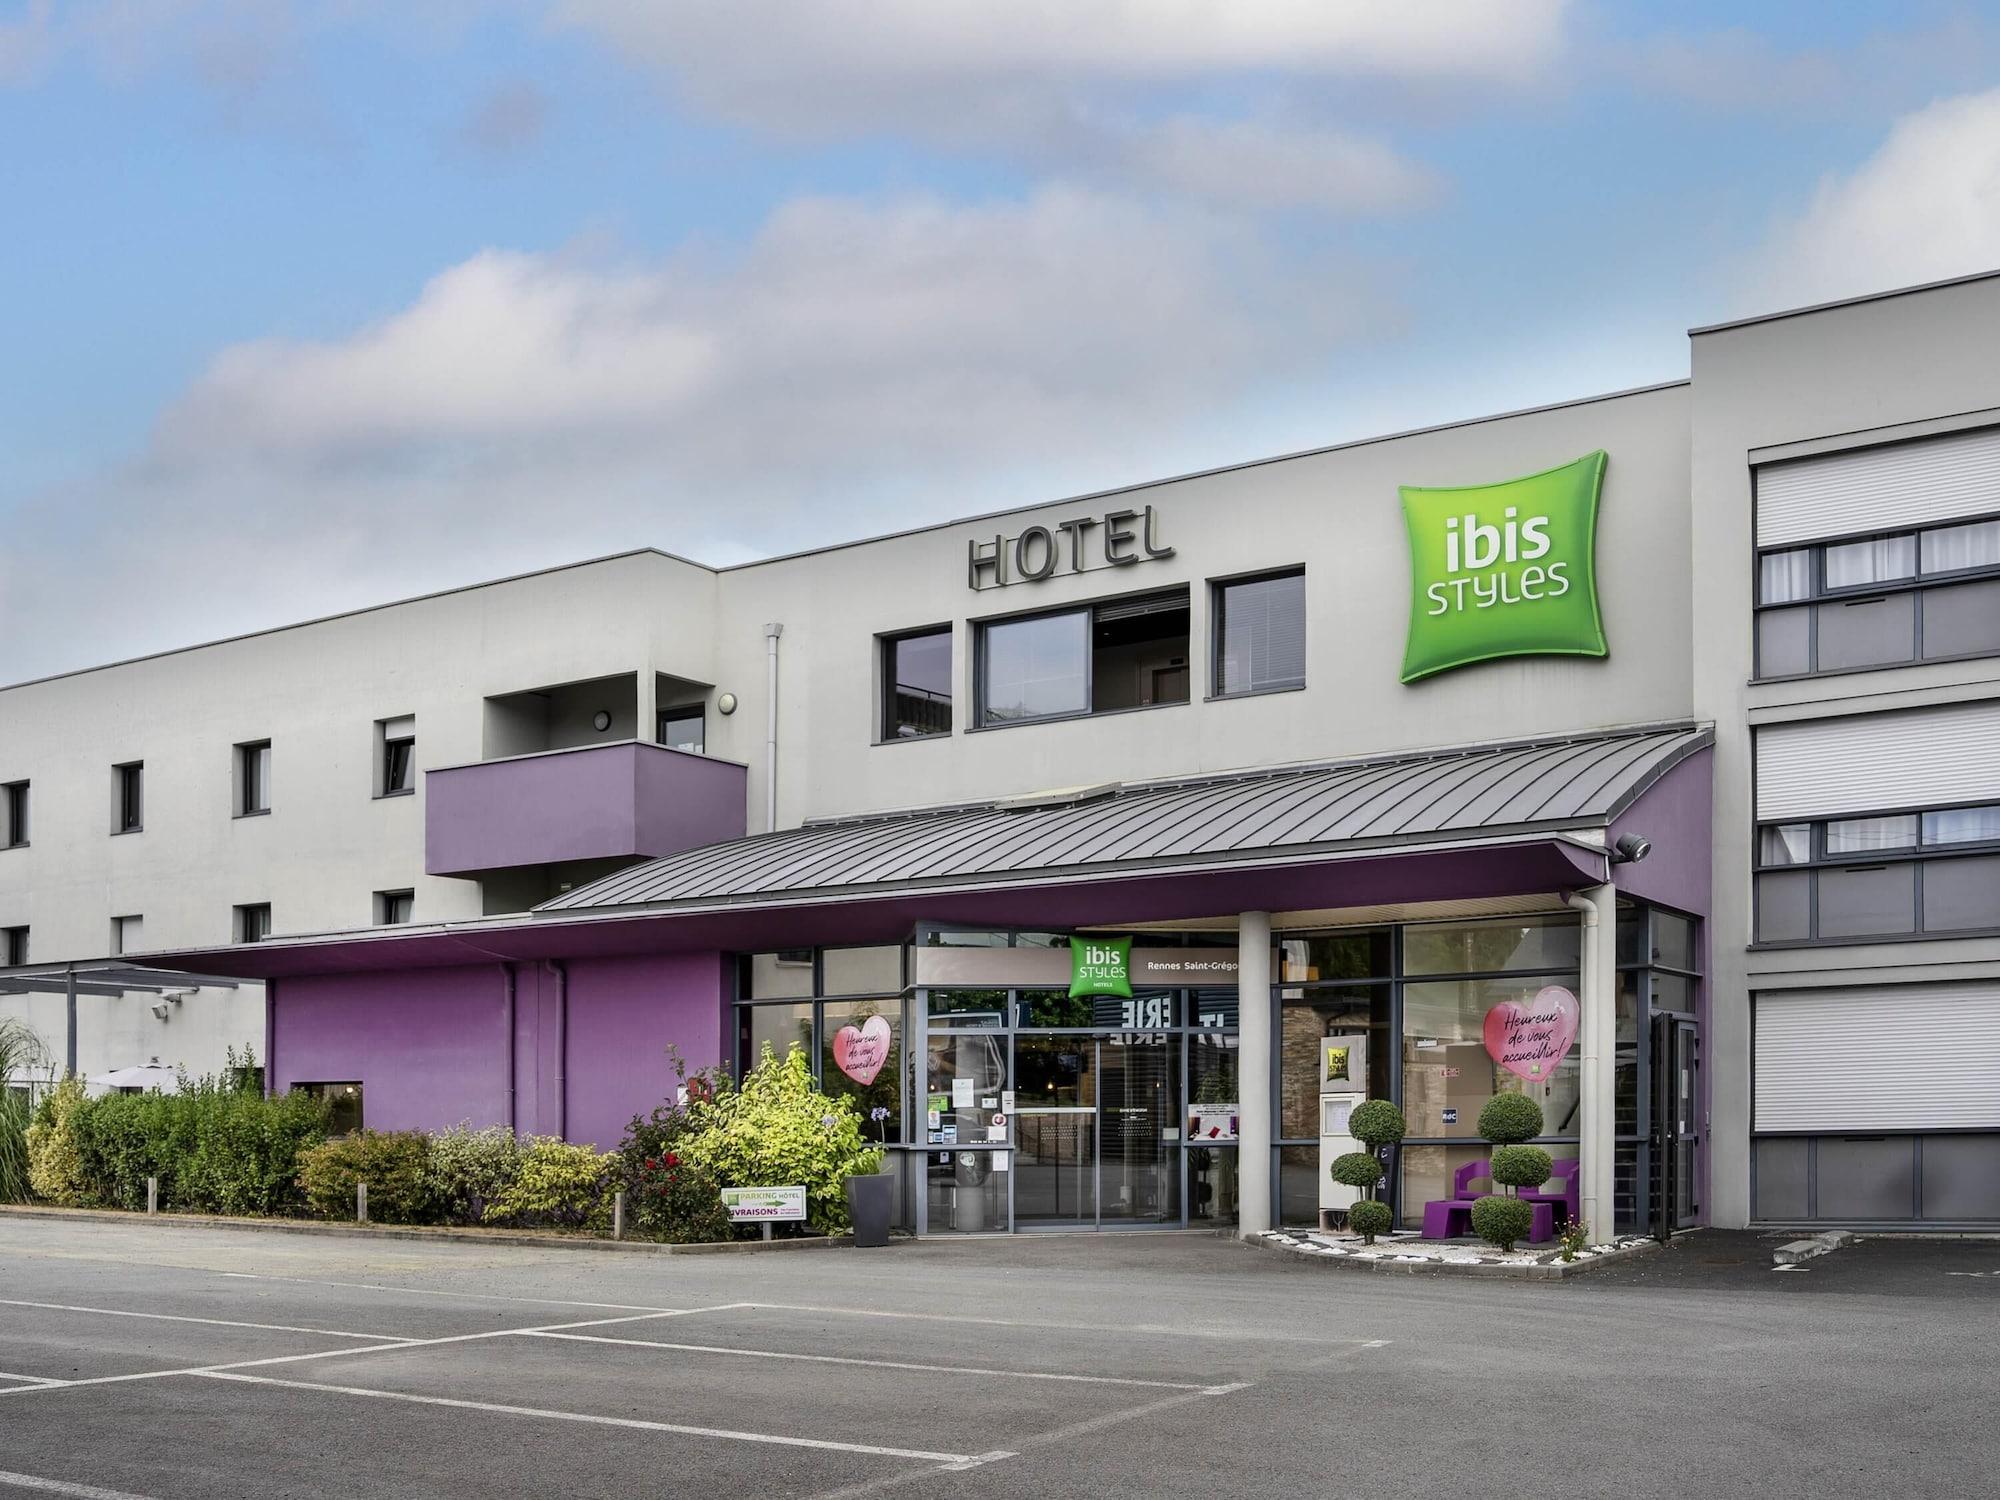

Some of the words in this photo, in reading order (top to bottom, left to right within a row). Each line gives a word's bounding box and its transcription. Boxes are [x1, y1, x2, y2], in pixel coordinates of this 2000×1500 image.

[968, 505, 1176, 591] HOTEL
[1446, 506, 1551, 573] ibis
[1086, 946, 1120, 965] ibis
[1147, 961, 1181, 970] Rennes
[1504, 1008, 1558, 1030] Heureux
[1508, 1029, 1525, 1048] de
[1527, 1029, 1554, 1041] vous
[1332, 1053, 1345, 1065] ibis
[740, 1192, 777, 1200] PARKING
[731, 1208, 778, 1216] IVRAISONS
